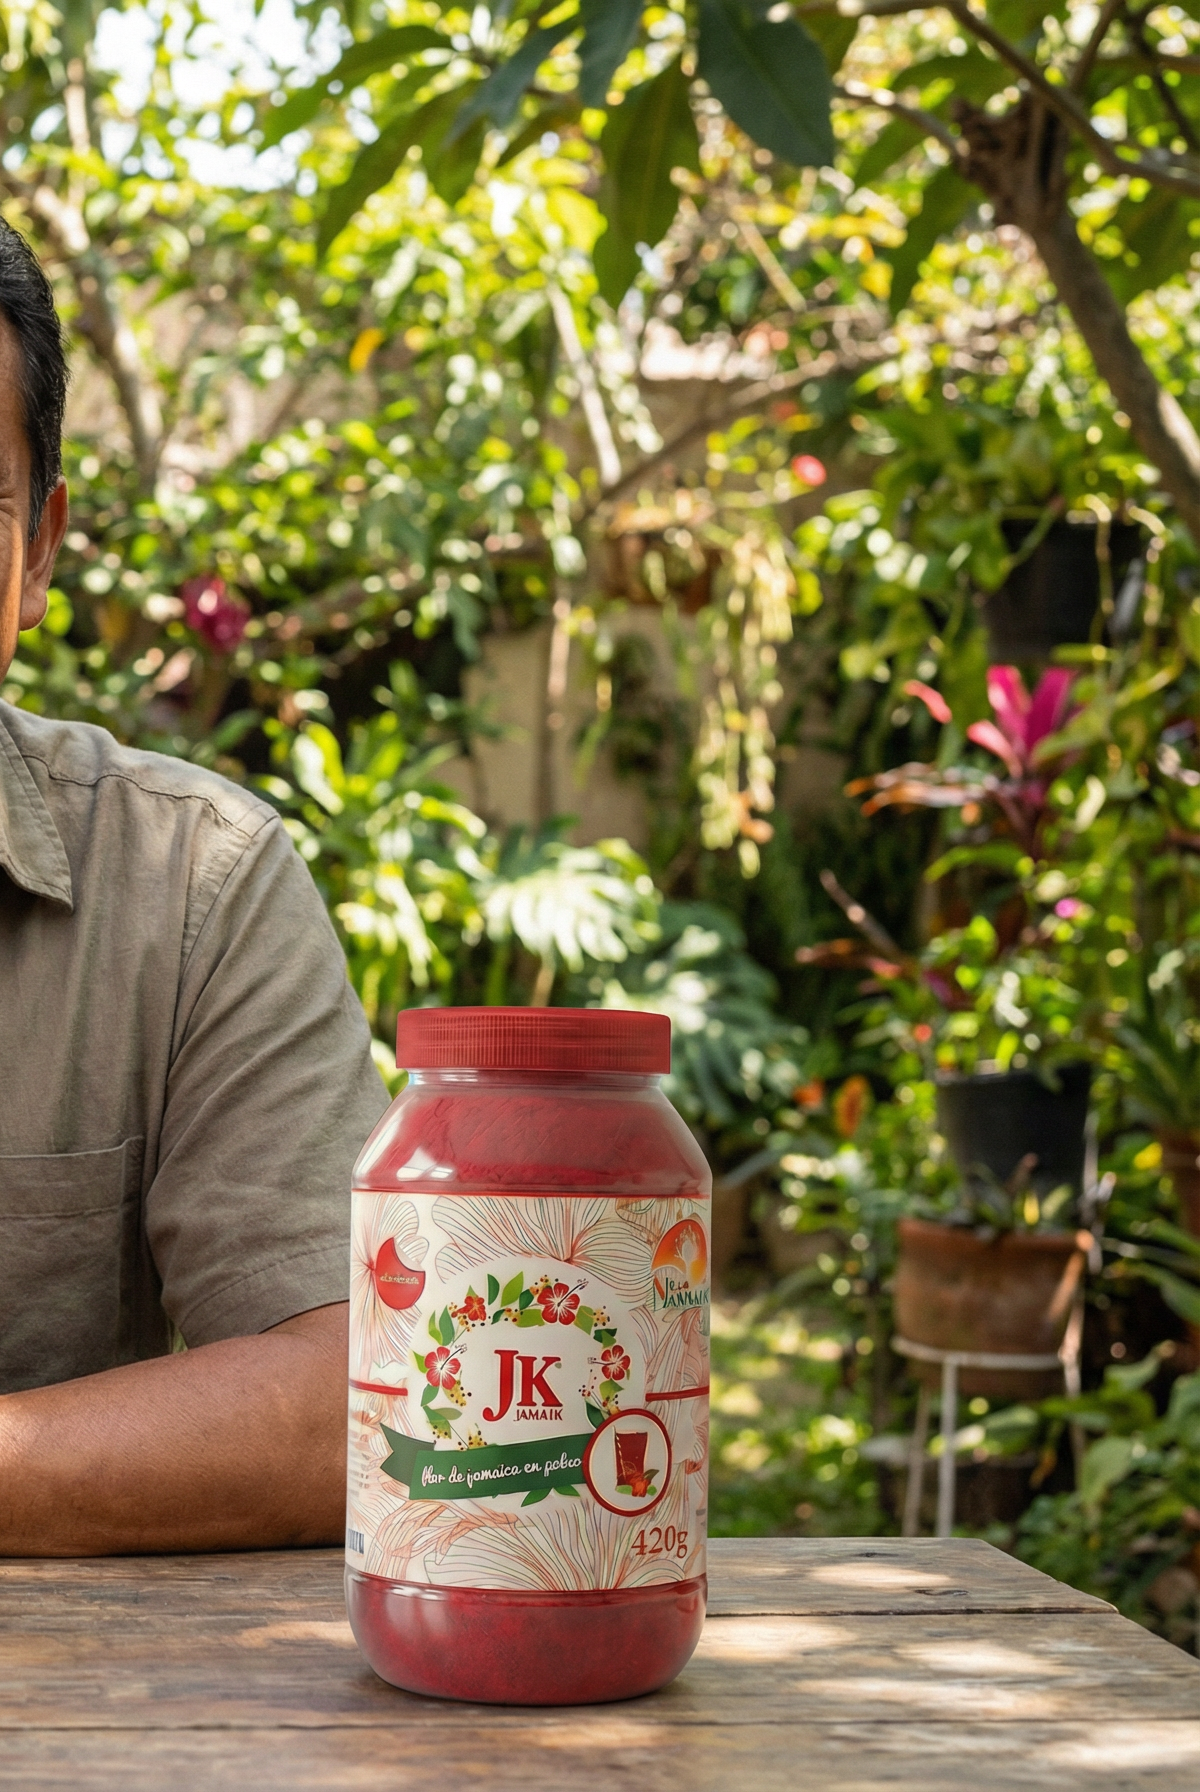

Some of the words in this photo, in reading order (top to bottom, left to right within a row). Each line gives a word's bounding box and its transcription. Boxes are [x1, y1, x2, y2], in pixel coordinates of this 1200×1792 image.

[482, 1349, 564, 1422] JK
[513, 1408, 563, 1421] JAMAIK
[448, 1465, 466, 1483] de
[523, 1462, 542, 1474] en
[630, 1524, 689, 1559] 420g
